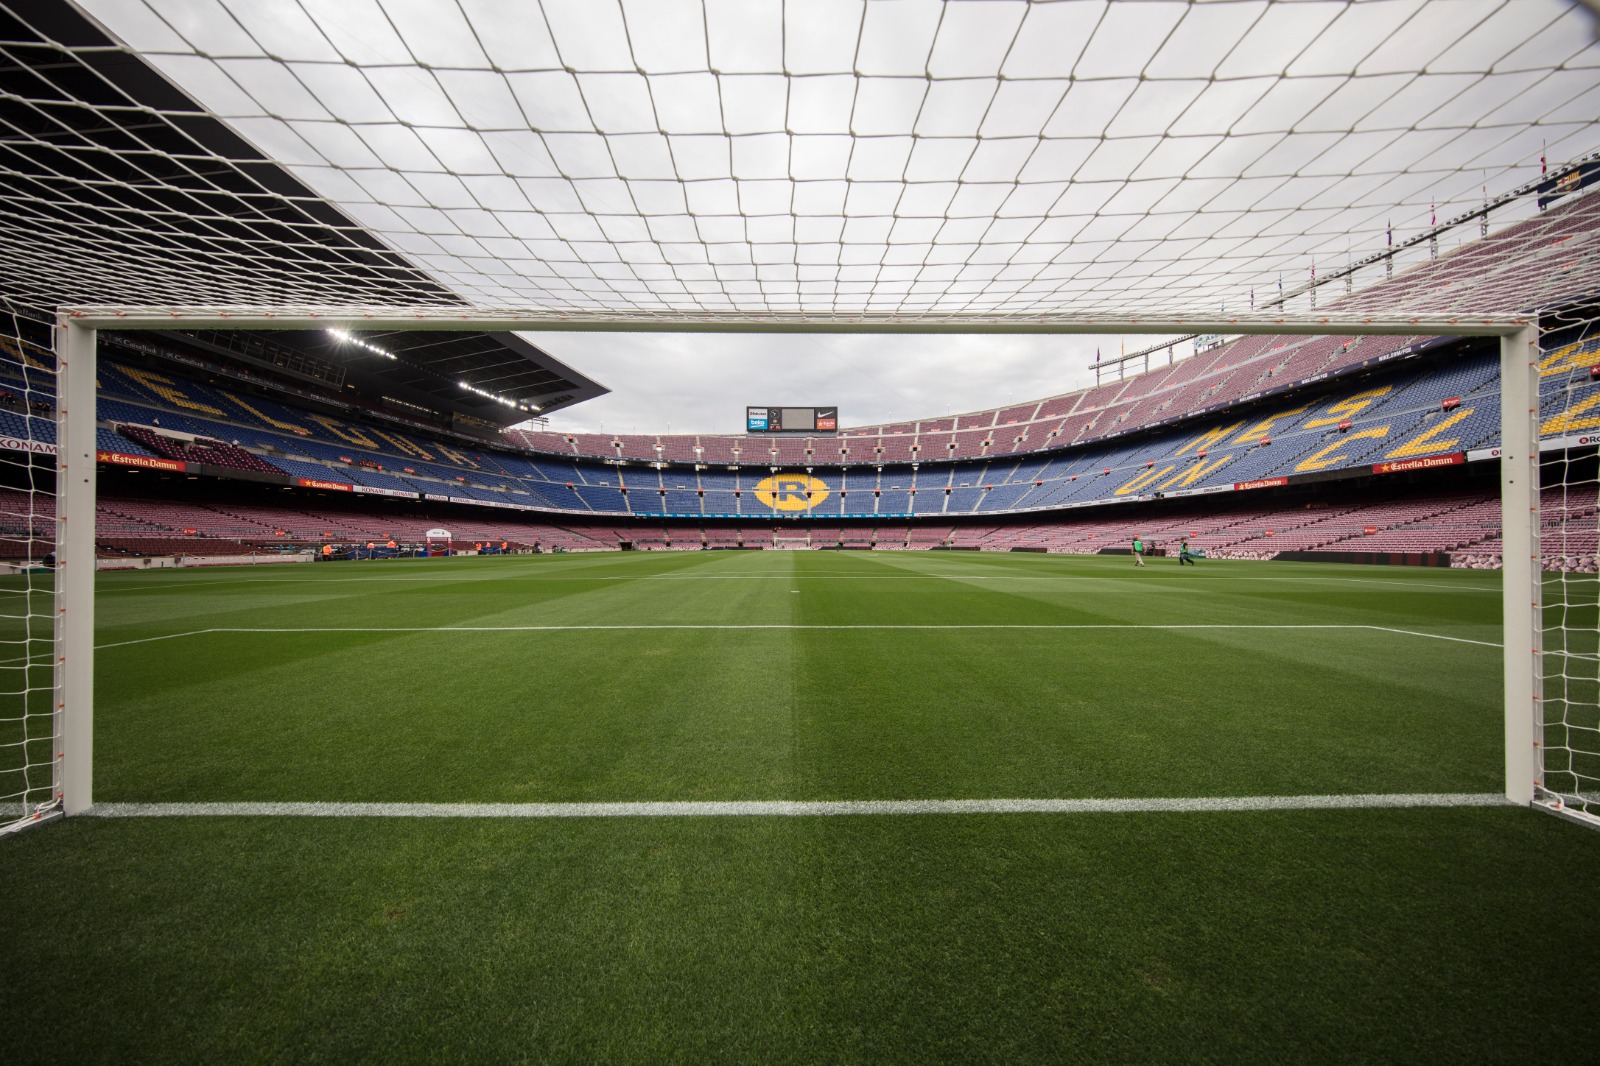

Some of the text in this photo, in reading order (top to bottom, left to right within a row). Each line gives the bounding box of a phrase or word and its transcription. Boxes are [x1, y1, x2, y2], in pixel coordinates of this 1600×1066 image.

[0, 439, 57, 454] KONAM
[112, 452, 178, 470] Estrella Damm
[1391, 457, 1453, 471] Estrella Damm
[311, 480, 333, 489] Estrella
